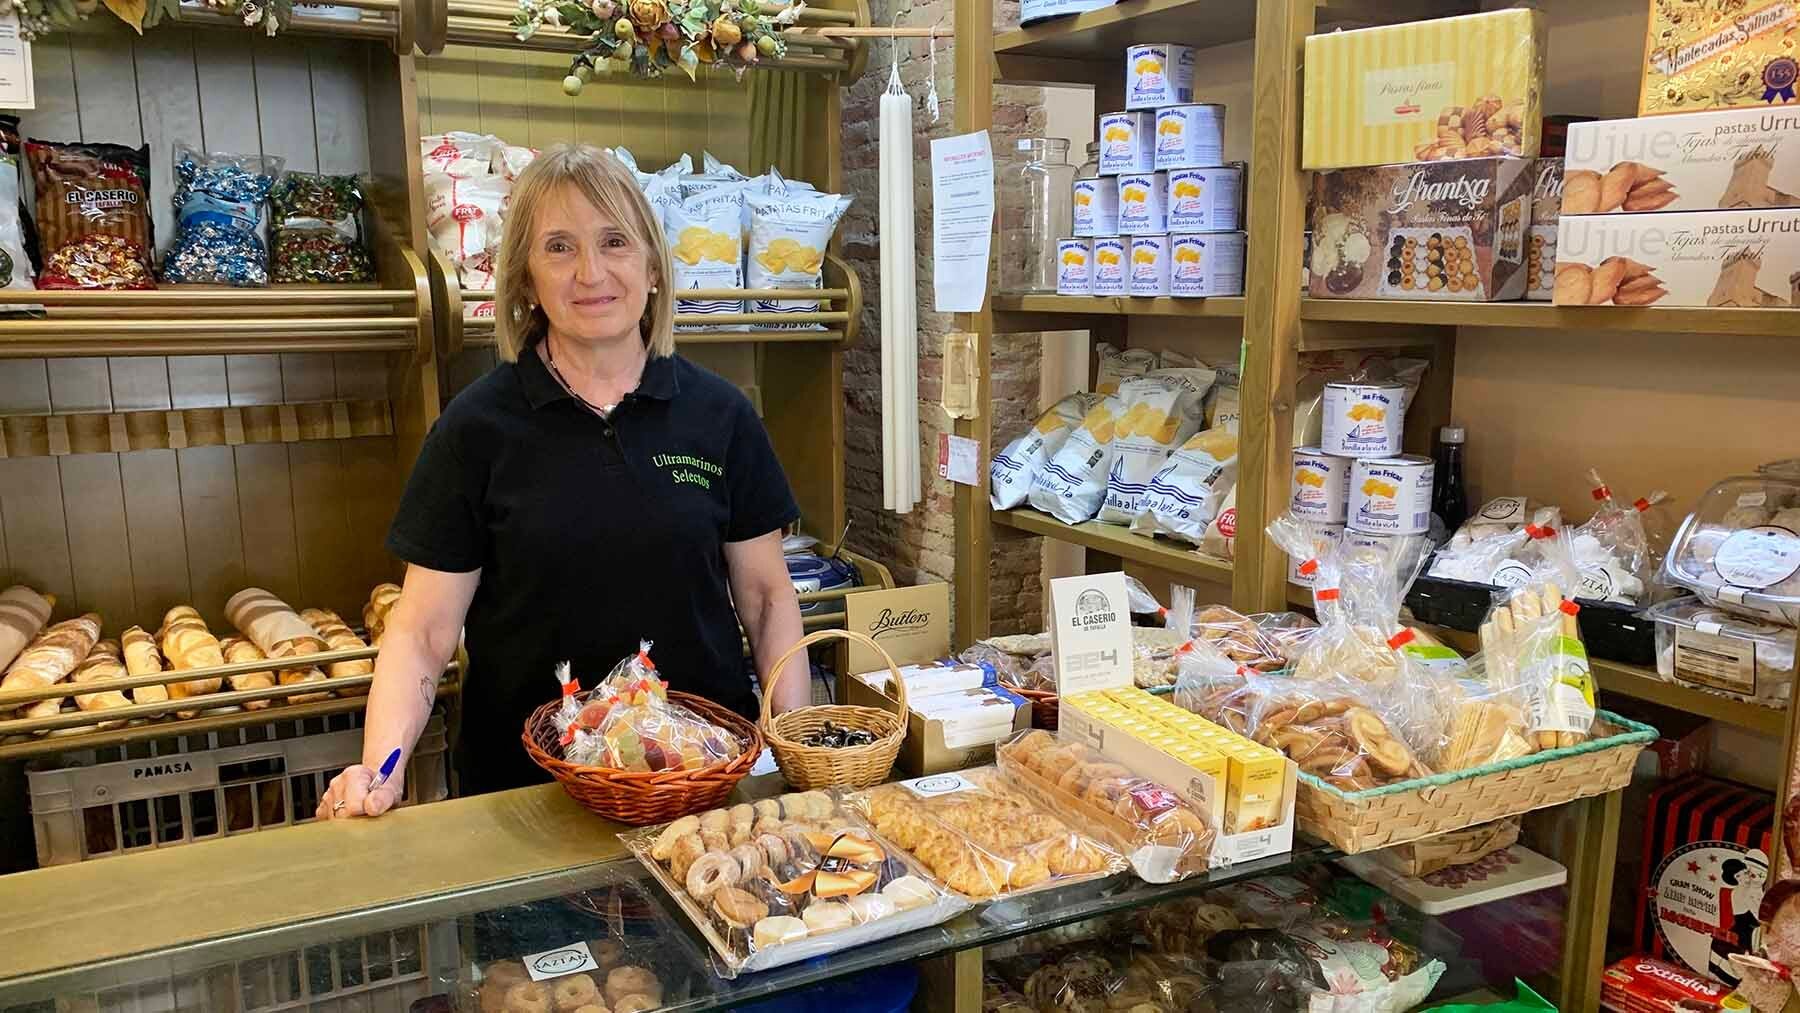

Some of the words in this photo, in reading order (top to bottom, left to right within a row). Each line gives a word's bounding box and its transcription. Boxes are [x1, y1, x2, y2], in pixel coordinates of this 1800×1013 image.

[1668, 31, 1738, 72] Mantecadas
[1735, 7, 1785, 44] Salinas
[1714, 123, 1757, 137] pastas
[85, 189, 138, 204] CASERIO
[1387, 170, 1489, 214] Arantxa
[1703, 224, 1745, 237] pastas
[652, 453, 723, 476] Ultramarinos
[672, 469, 710, 489] Selectos
[869, 608, 931, 634] Butlers
[1072, 616, 1081, 627] EL
[1083, 612, 1116, 625] CASERIO
[134, 761, 193, 779] PANASA
[1691, 884, 1716, 900] SHOW
